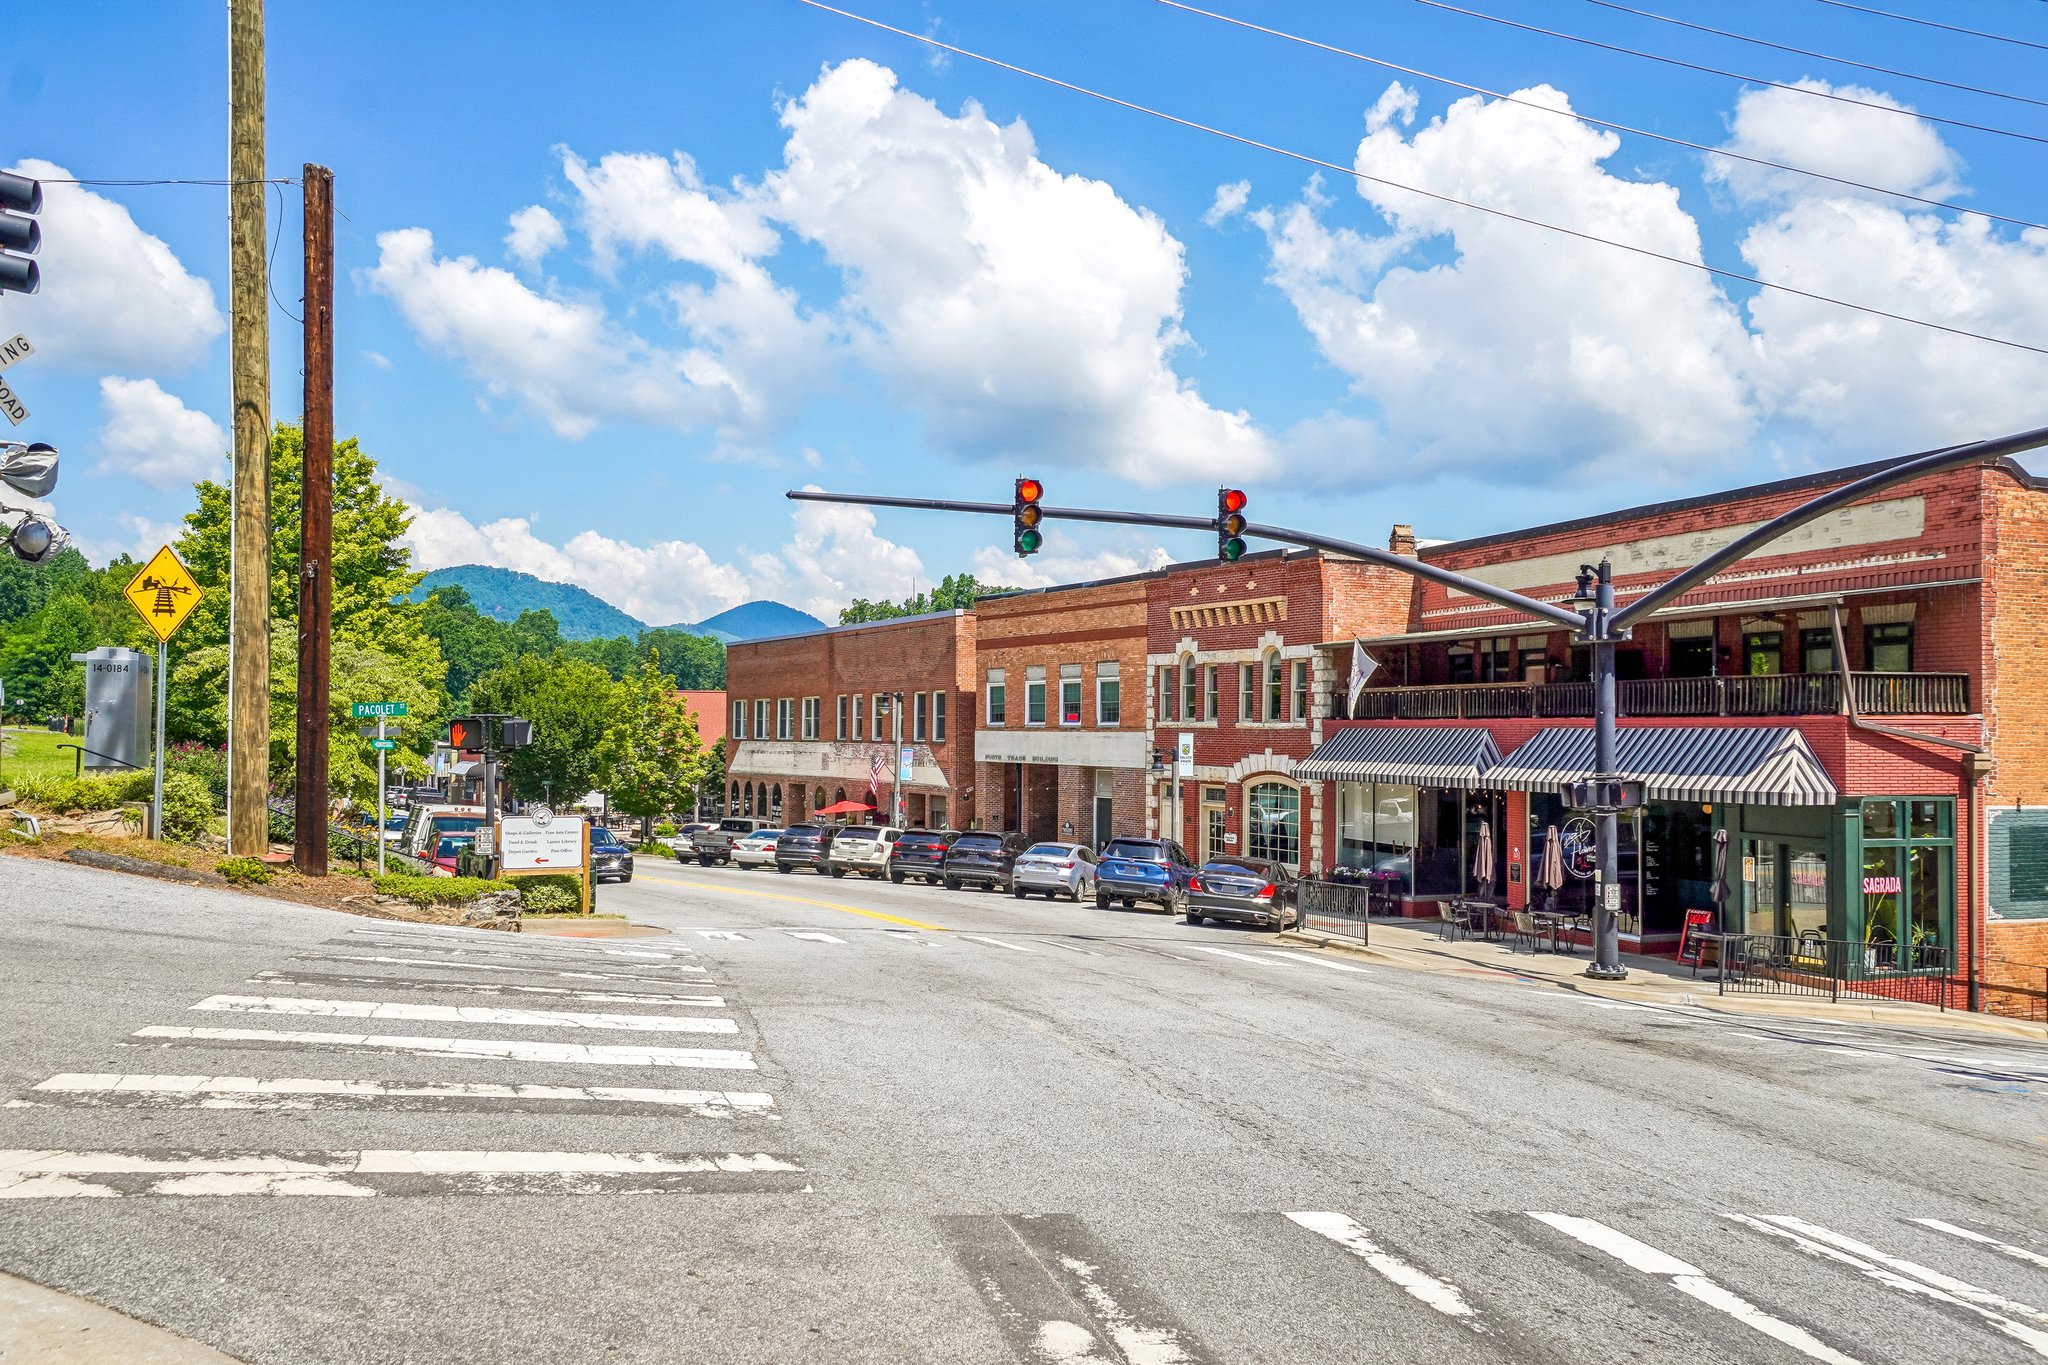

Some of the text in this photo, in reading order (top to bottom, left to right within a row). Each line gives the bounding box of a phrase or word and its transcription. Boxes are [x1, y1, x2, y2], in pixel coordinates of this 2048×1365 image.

[0, 380, 25, 419] OAD
[93, 664, 129, 673] 14-0184
[358, 704, 395, 716] PACOLET
[1863, 877, 1902, 894] SAGRADA
